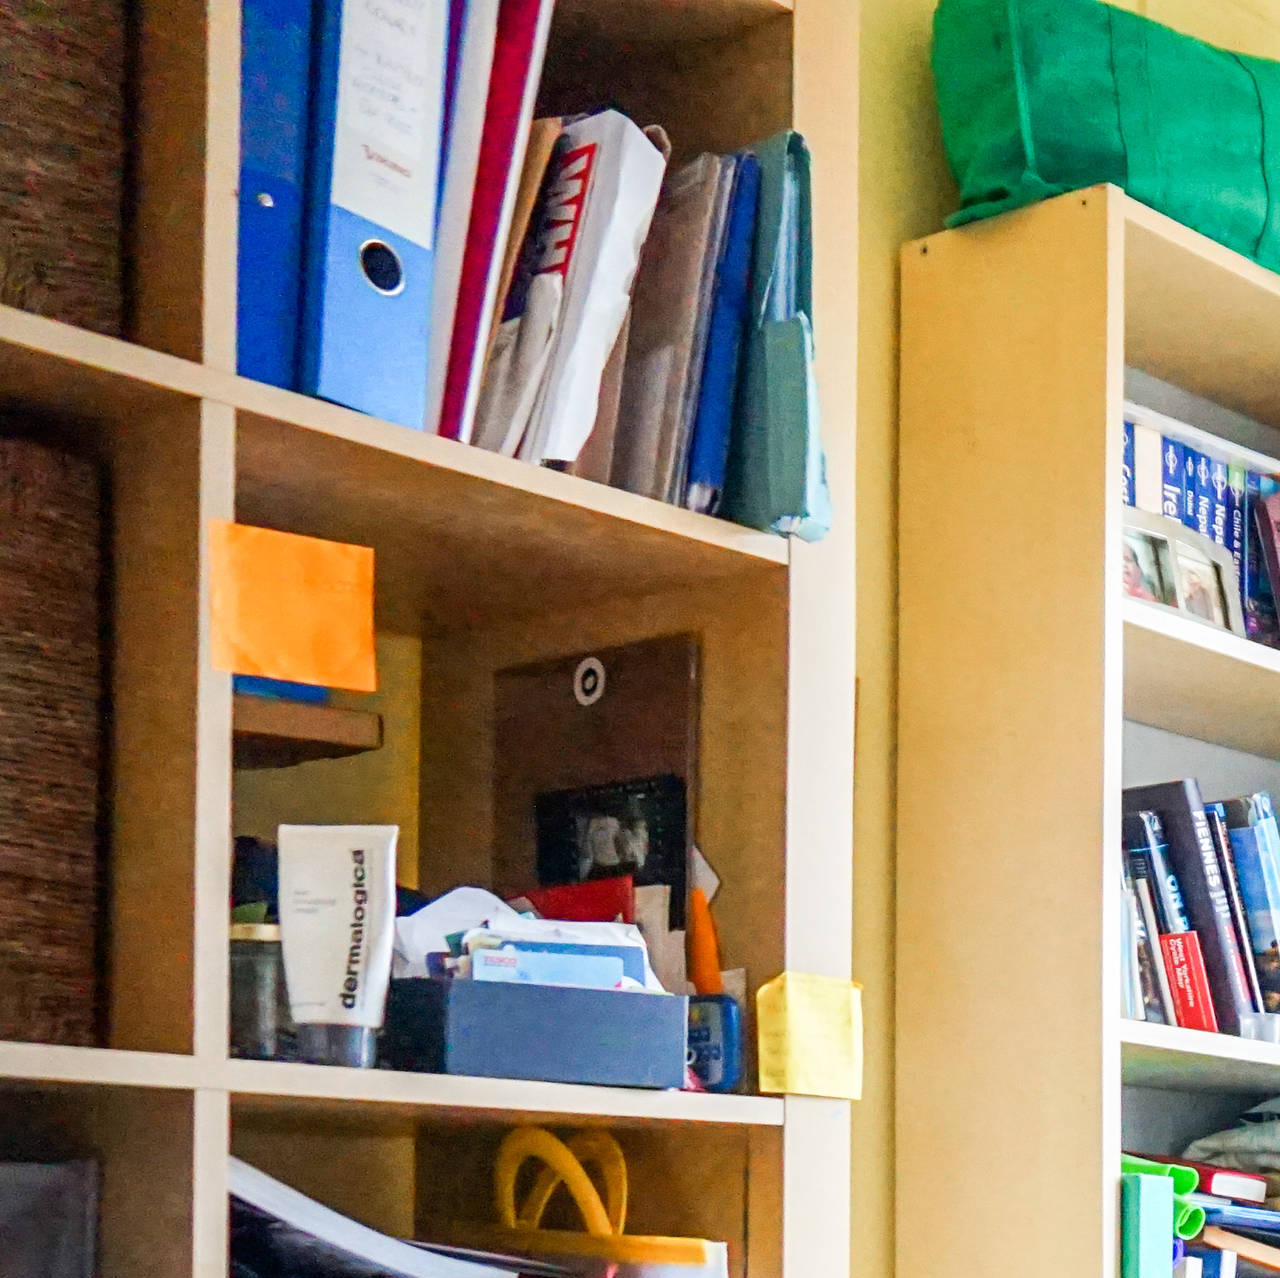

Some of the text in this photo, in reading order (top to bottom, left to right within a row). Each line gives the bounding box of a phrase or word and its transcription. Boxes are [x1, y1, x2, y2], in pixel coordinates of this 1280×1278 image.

[1233, 509, 1242, 537] Chile
[1192, 810, 1221, 888] FIENNES
[339, 849, 368, 1010] dermalogica
[1175, 937, 1195, 1008] West Yorkshire
